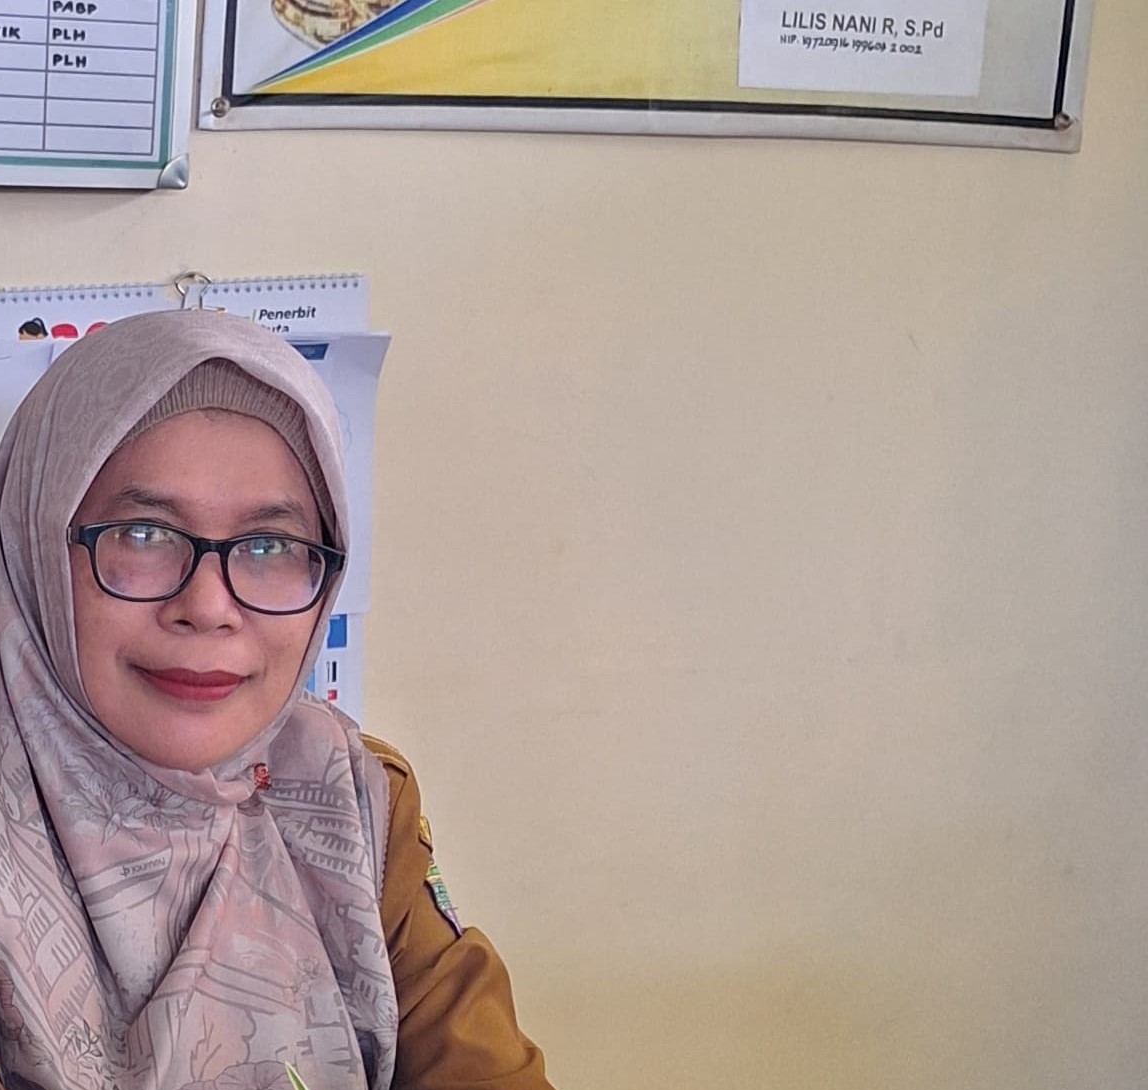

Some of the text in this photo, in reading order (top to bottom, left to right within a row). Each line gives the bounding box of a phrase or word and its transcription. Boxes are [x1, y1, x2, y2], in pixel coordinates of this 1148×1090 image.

[52, 1, 97, 14] PABP
[781, 11, 944, 38] LILIS NANI R, S.Pd
[52, 28, 86, 41] PLH
[52, 54, 87, 68] PLH
[259, 305, 316, 320] Penerbit
